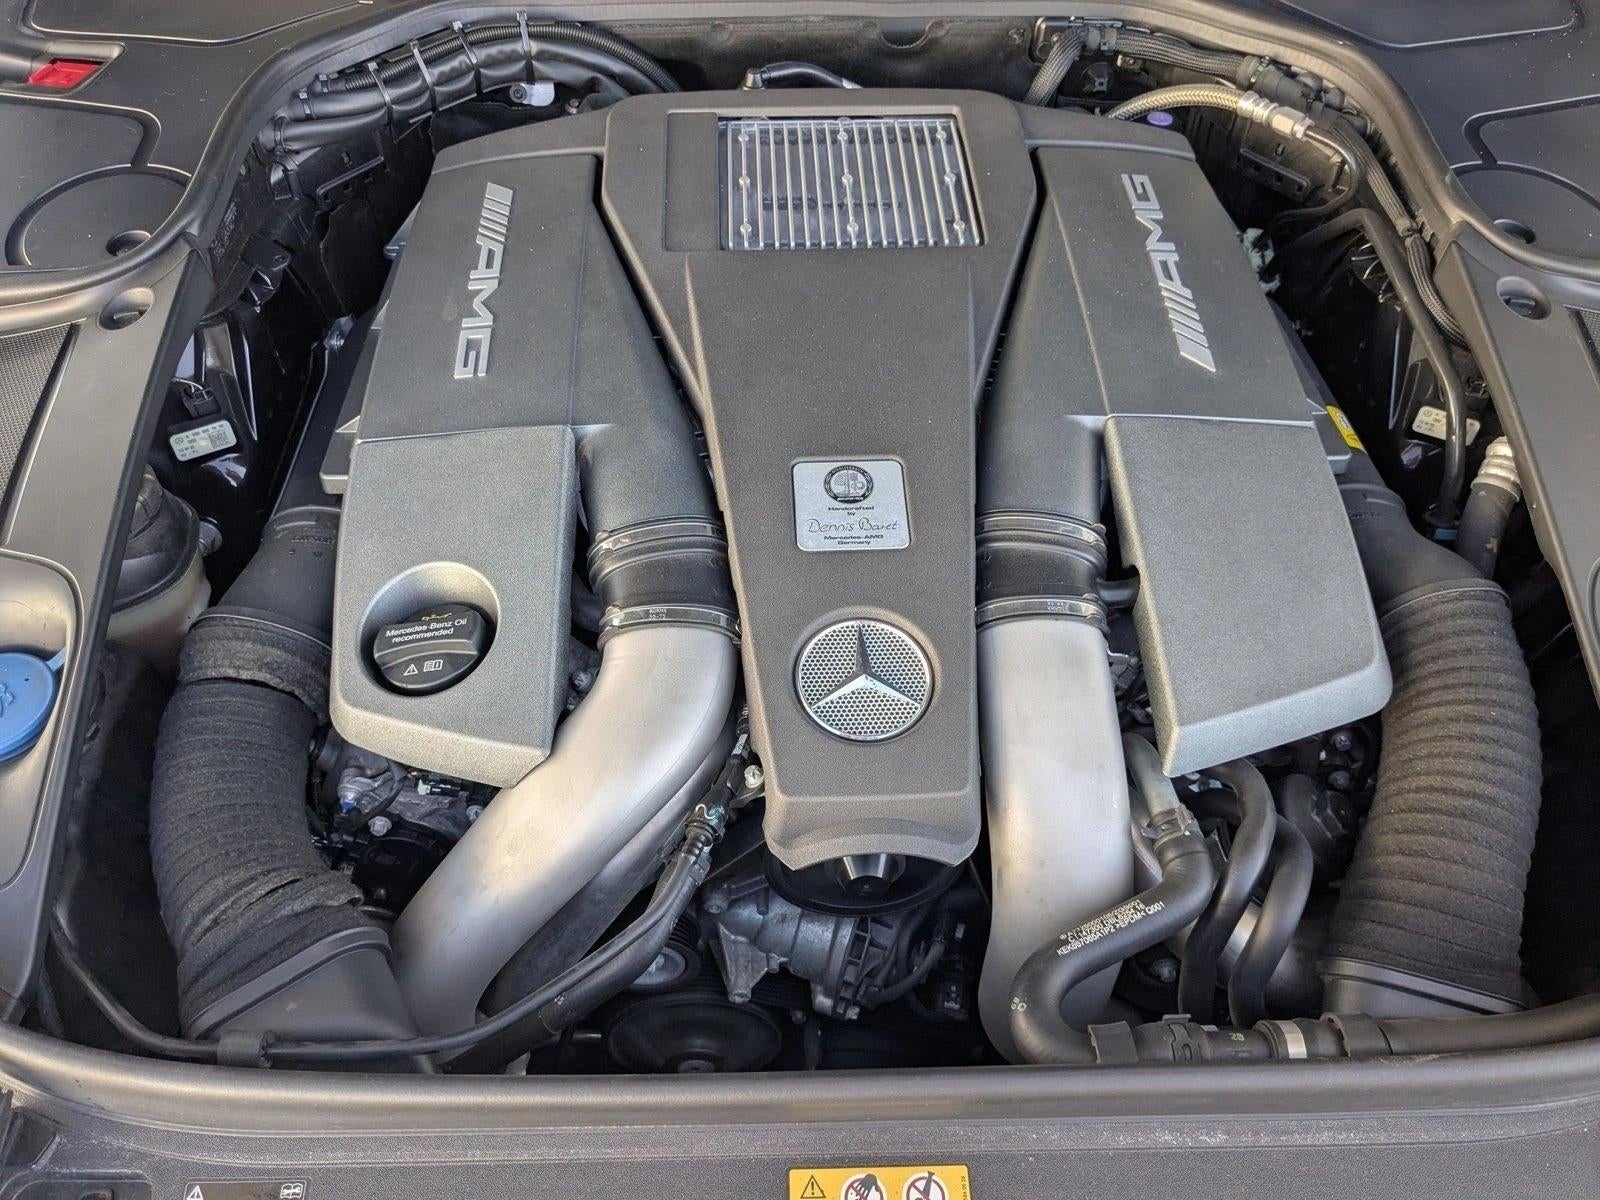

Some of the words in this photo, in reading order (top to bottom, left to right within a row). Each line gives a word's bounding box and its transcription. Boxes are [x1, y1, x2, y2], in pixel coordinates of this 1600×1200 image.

[1121, 173, 1193, 299] AMG
[453, 235, 504, 379] AMG
[807, 518, 855, 533] Dennis
[385, 621, 453, 637] Mercedes-Benz
[454, 618, 467, 626] Oil
[392, 627, 454, 643] recommended
